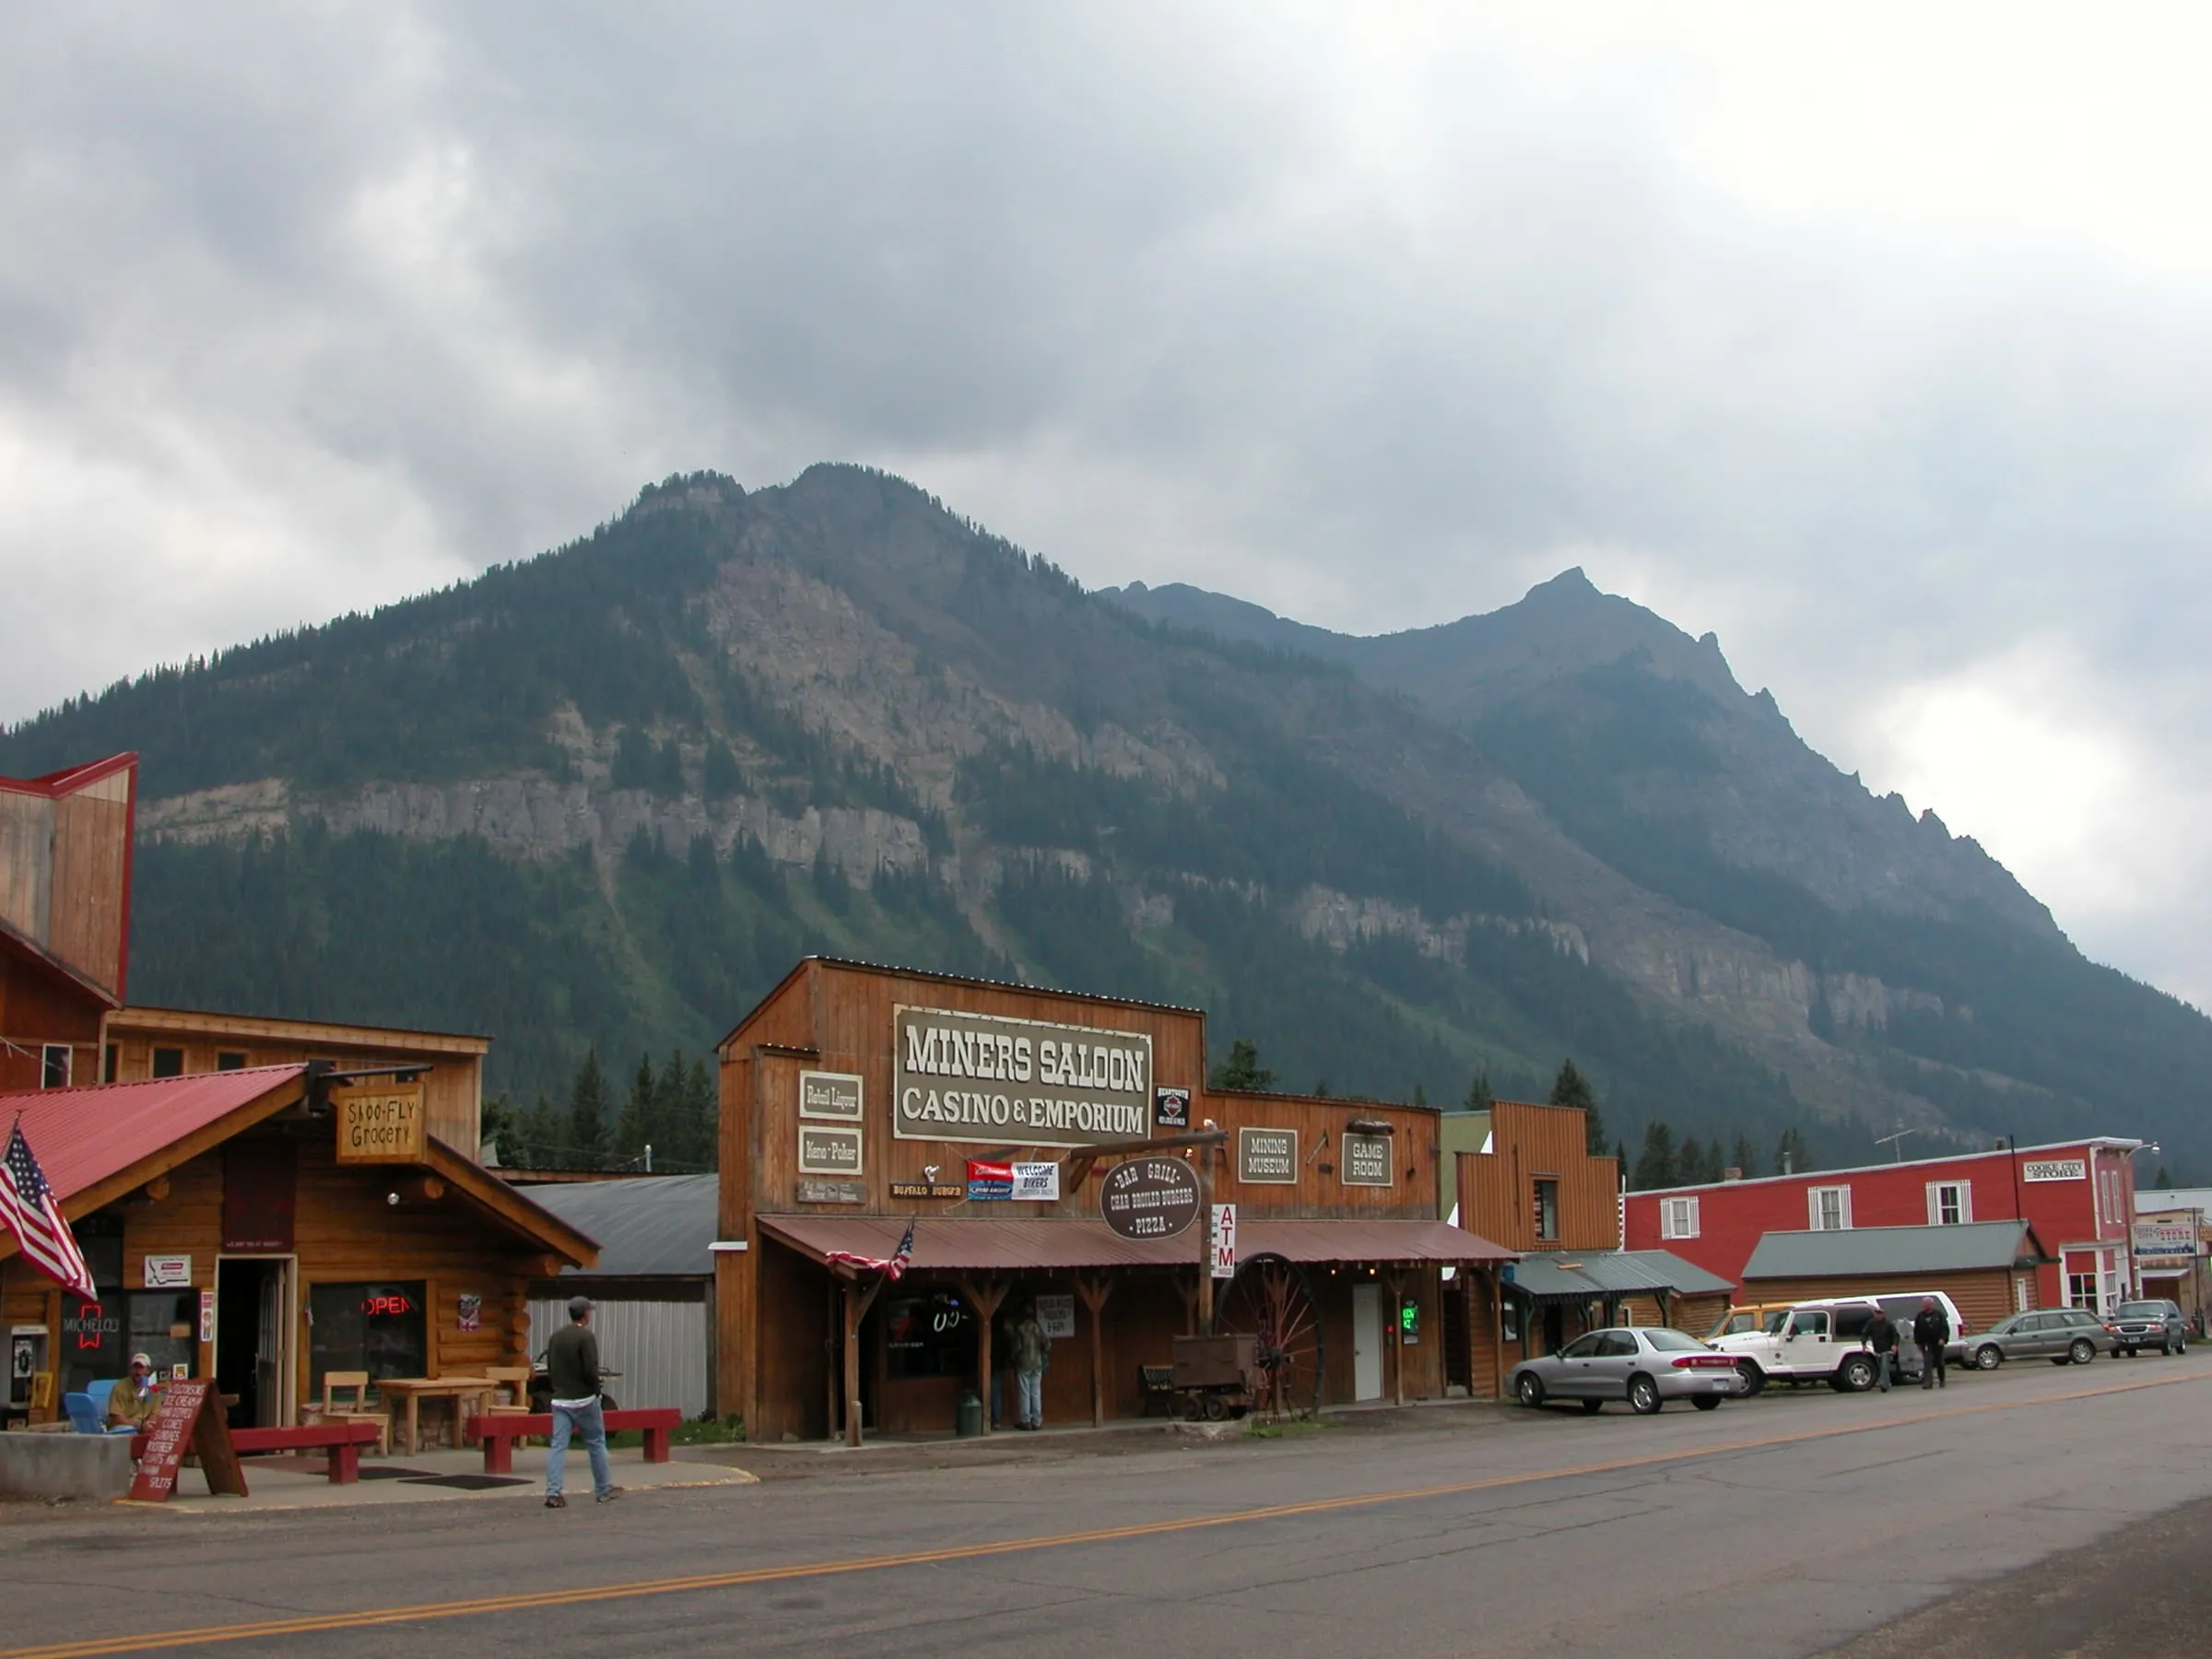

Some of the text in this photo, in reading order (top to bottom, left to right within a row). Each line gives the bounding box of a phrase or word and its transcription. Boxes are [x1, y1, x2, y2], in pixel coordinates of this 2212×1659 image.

[905, 1024, 1144, 1092] MINERS SALOON
[806, 1085, 856, 1110] Retail Liquor
[902, 1087, 1144, 1135] CASINO & EMPORIUM
[352, 1125, 410, 1147] Grocery
[806, 1140, 827, 1160] Keno
[831, 1142, 856, 1161] Poker
[1251, 1137, 1288, 1154] MINING
[1353, 1143, 1382, 1159] GAME
[1017, 1165, 1054, 1176] WELCOME
[1248, 1158, 1289, 1173] MUSEUM
[1353, 1161, 1382, 1176] ROOM
[2028, 1162, 2082, 1172] COOKE CITY
[2033, 1170, 2078, 1178] STORE
[1023, 1178, 1049, 1188] BIKERS
[1116, 1163, 1177, 1189] BAR GRILL
[893, 1185, 927, 1195] BUFFALO
[932, 1186, 961, 1196] BURGER
[1111, 1187, 1194, 1211] CHAR BROILED BURGERS
[1135, 1217, 1166, 1234] PIZZA
[1218, 1206, 1233, 1266] ATM
